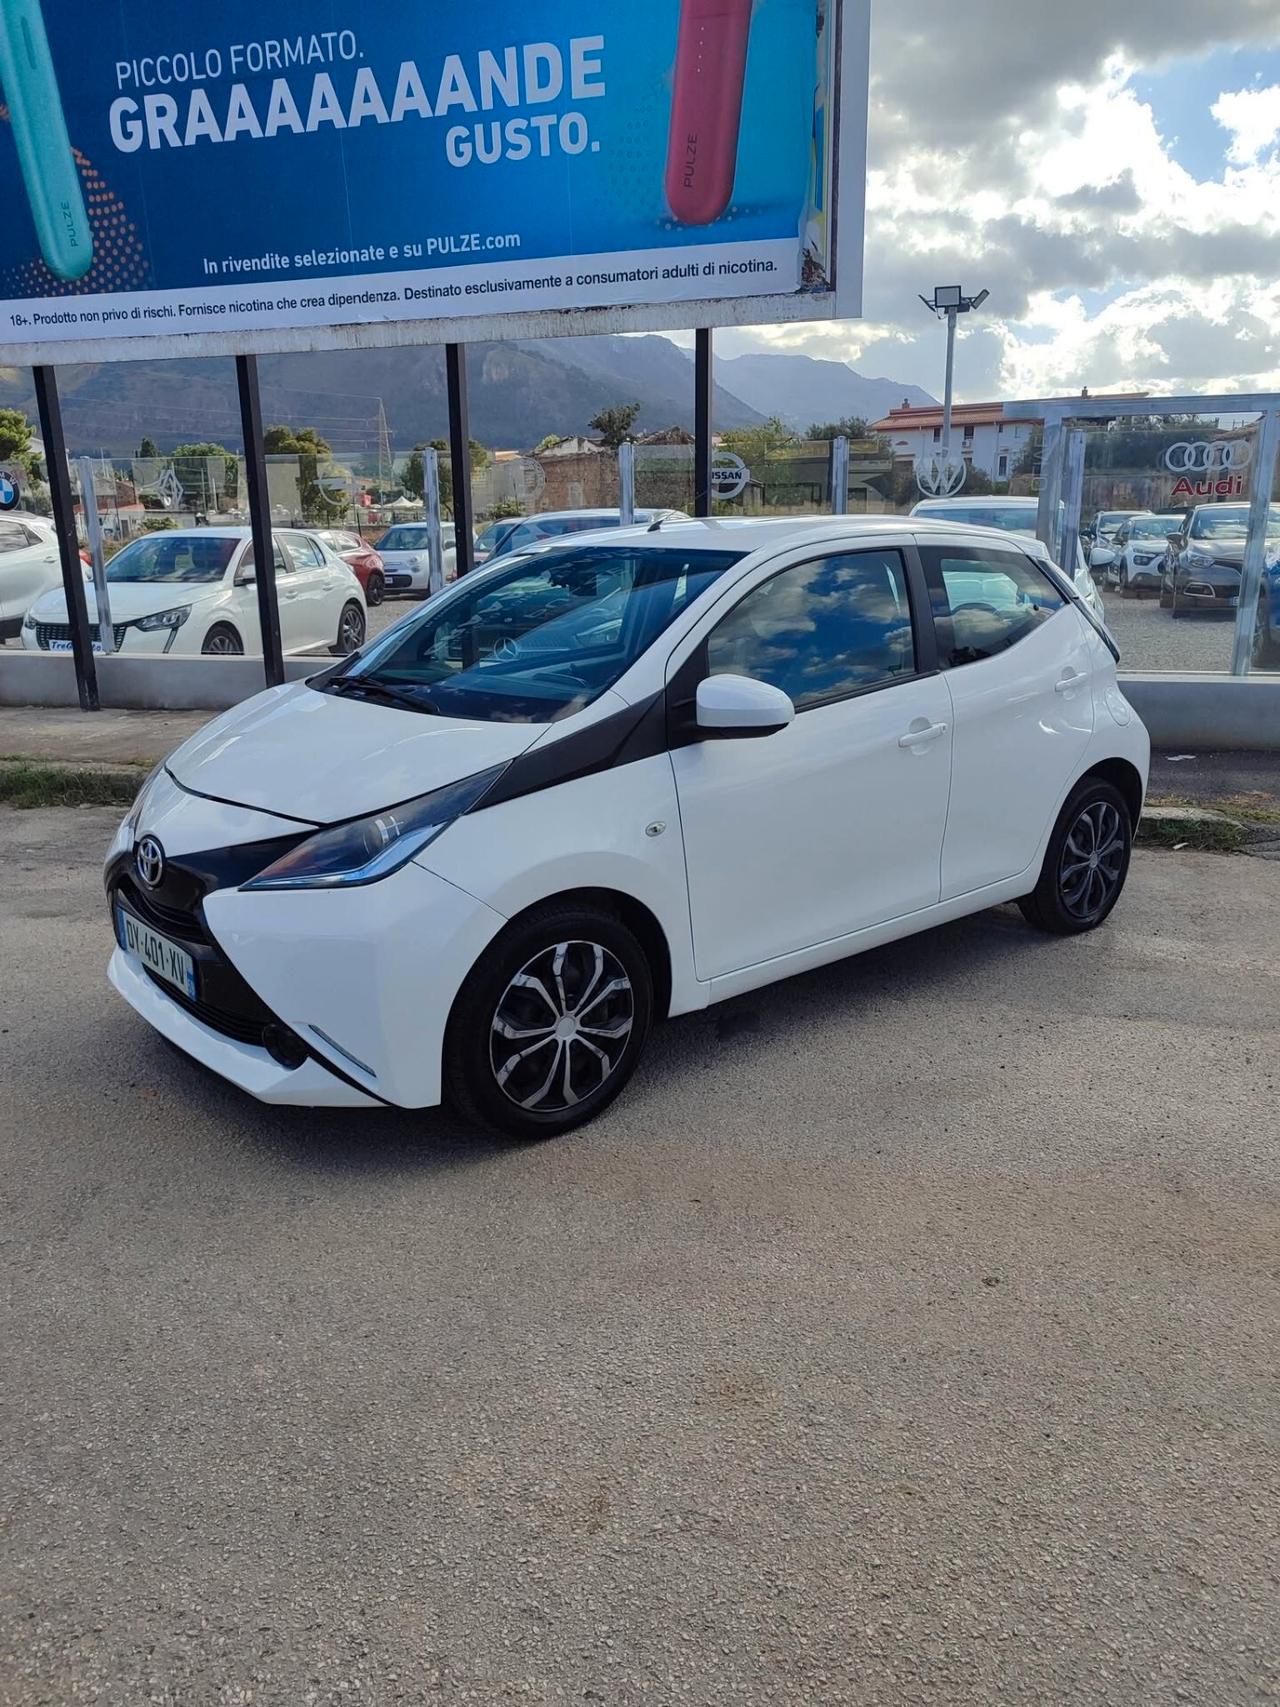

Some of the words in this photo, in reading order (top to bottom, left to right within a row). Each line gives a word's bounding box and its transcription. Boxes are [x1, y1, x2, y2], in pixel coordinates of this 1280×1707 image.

[115, 49, 222, 90] PICCOLO
[230, 29, 364, 74] FORMATO.
[109, 35, 606, 153] GRAAAAAAANDE
[445, 112, 600, 168] GUSTO.
[685, 133, 698, 188] PULZE
[60, 201, 79, 247] PULZE
[203, 258, 218, 274] In
[222, 253, 290, 272] rivendite
[294, 245, 385, 267] selezionate
[389, 245, 399, 258] e
[403, 243, 423, 257] su
[426, 233, 521, 255] PULZE.com
[10, 314, 32, 327] 18+.
[33, 310, 78, 325] Prodotto
[80, 310, 100, 321] non
[102, 307, 129, 323] privo
[130, 306, 141, 319] di
[143, 304, 177, 318] rischi.
[178, 302, 227, 316] Fornisce
[229, 299, 275, 313] nicotina
[276, 297, 297, 310] che
[300, 295, 326, 308] crea
[328, 290, 401, 308] dipendenza.
[404, 283, 462, 300] Destinato
[465, 275, 562, 295] esclusivamente
[565, 275, 574, 286] a
[576, 266, 659, 286] consumatori
[661, 263, 700, 279] adulti
[702, 262, 716, 276] di
[718, 258, 778, 275] nicotina.
[711, 471, 742, 480] ISSAN
[1171, 475, 1244, 497] Audi
